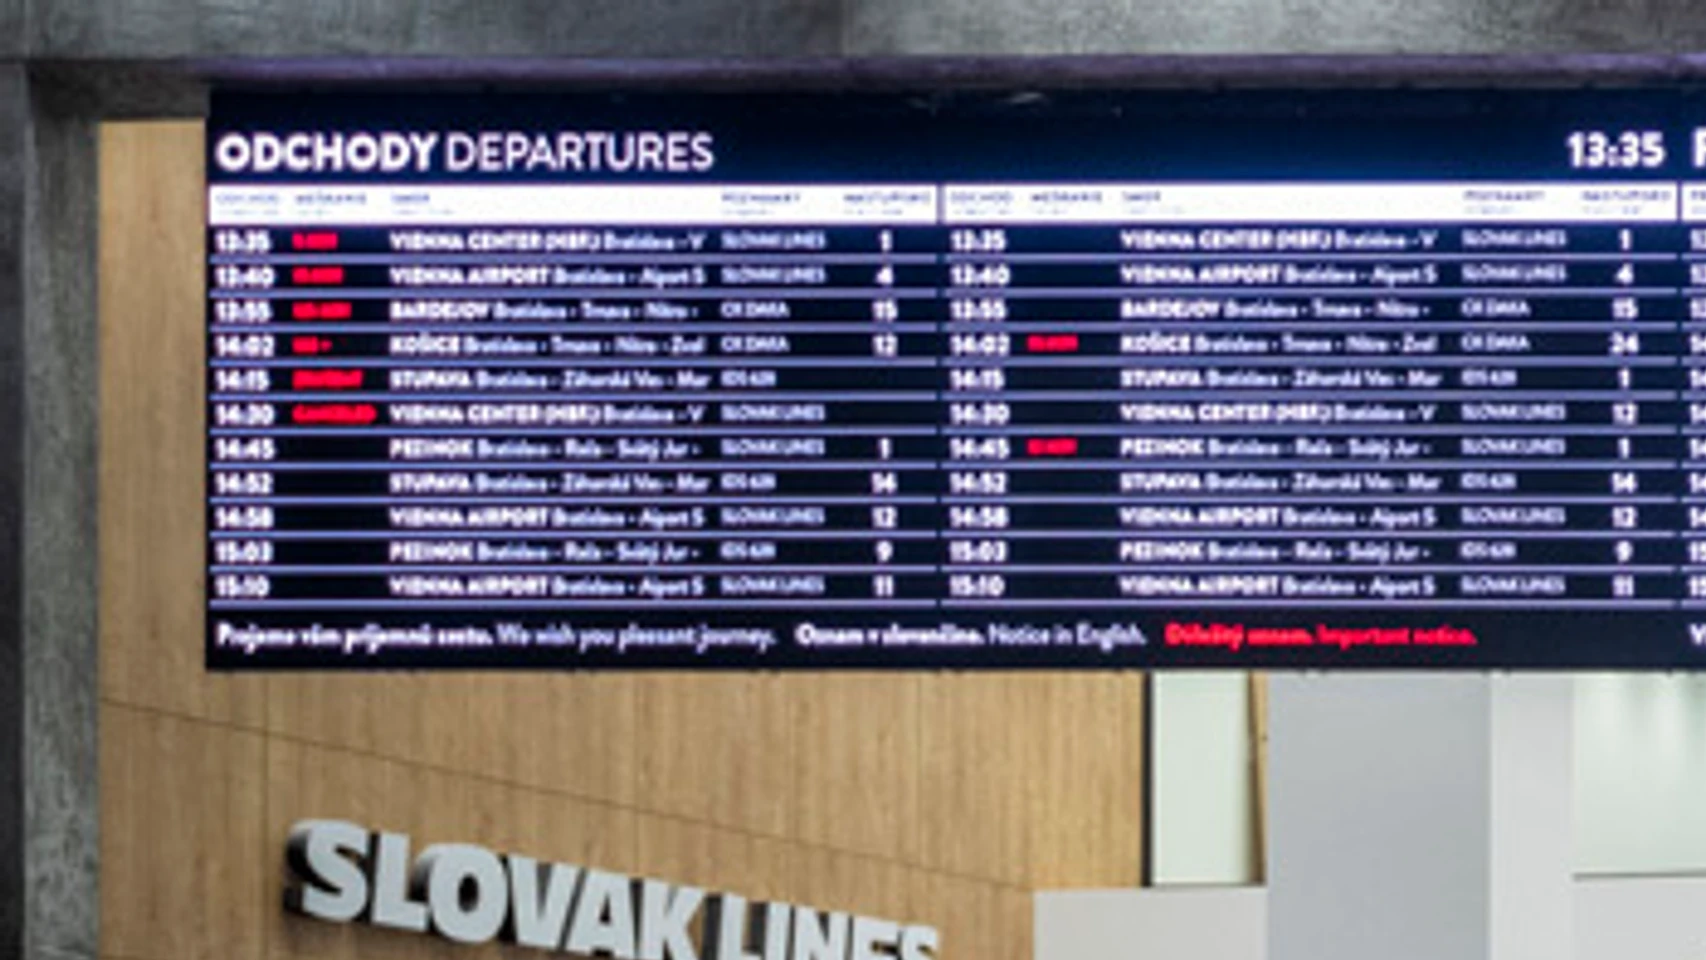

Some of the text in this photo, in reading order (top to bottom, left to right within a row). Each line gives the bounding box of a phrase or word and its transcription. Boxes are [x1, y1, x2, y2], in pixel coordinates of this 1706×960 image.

[217, 133, 713, 171] ODCHODY DEPARTURES
[1569, 132, 1665, 167] 13:35
[216, 230, 271, 253] 13:35
[951, 230, 1006, 251] 13:35
[216, 264, 275, 288] 13:40
[951, 264, 1010, 285] 13:40
[216, 299, 271, 322] 13:55
[951, 298, 1006, 320] 13:55
[217, 335, 274, 357] 14:02
[951, 332, 1010, 356] 14:02
[216, 370, 269, 391] 14:15
[951, 368, 1004, 390] 14:15
[217, 404, 274, 425] 14:30
[951, 403, 1010, 425] 14:30
[216, 438, 275, 459] 14:45
[951, 438, 1010, 459] 14:45
[216, 472, 273, 494] 14:52
[951, 472, 1006, 493] 14:52
[216, 507, 273, 528] 14:58
[950, 507, 1008, 527] 14:58
[216, 541, 272, 562] 15:03
[950, 541, 1006, 561] 15:03
[216, 575, 269, 596] 15:10
[950, 575, 1004, 596] 15:10
